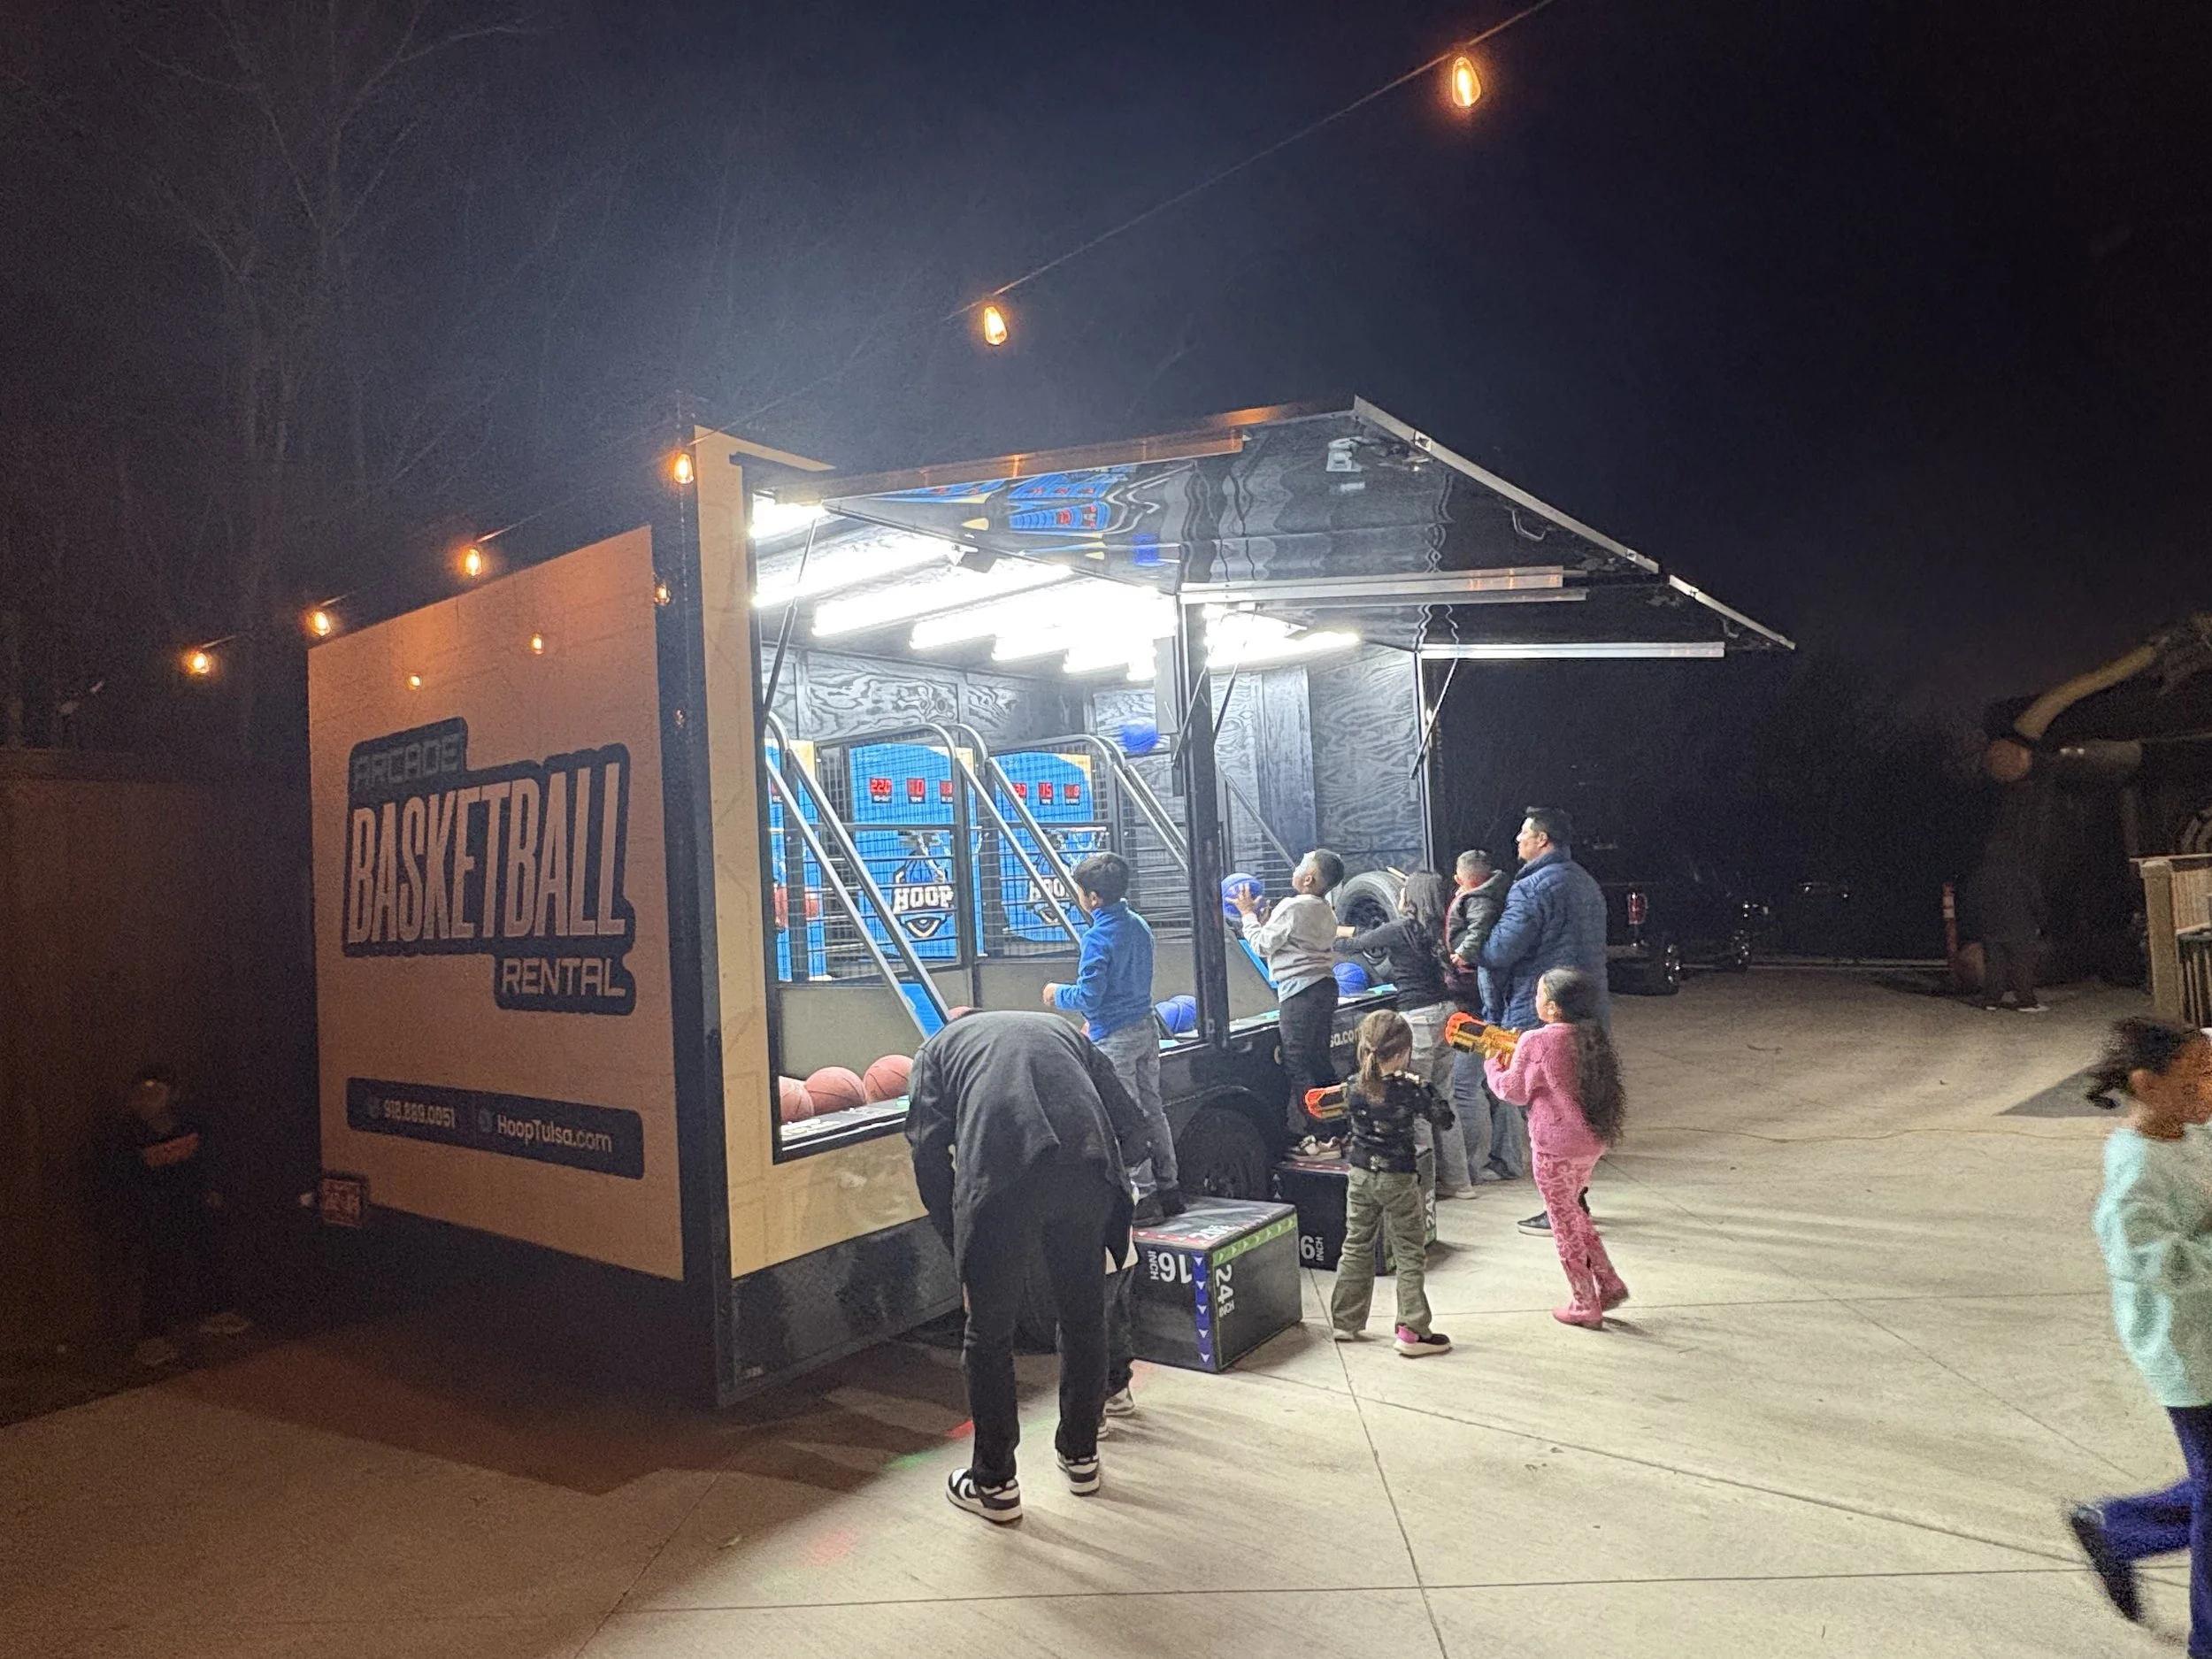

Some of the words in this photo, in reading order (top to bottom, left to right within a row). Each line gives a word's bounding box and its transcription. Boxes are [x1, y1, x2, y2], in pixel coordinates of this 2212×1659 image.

[354, 733, 462, 790] ARCADE
[348, 763, 626, 943] BASKETBALL
[893, 884, 955, 915] HOOP
[502, 956, 626, 997] RENTAL
[496, 1113, 613, 1153] HoopTulsa.com
[1147, 1250, 1160, 1280] INCH
[1157, 1252, 1193, 1284] 16
[1215, 1263, 1234, 1304] 24
